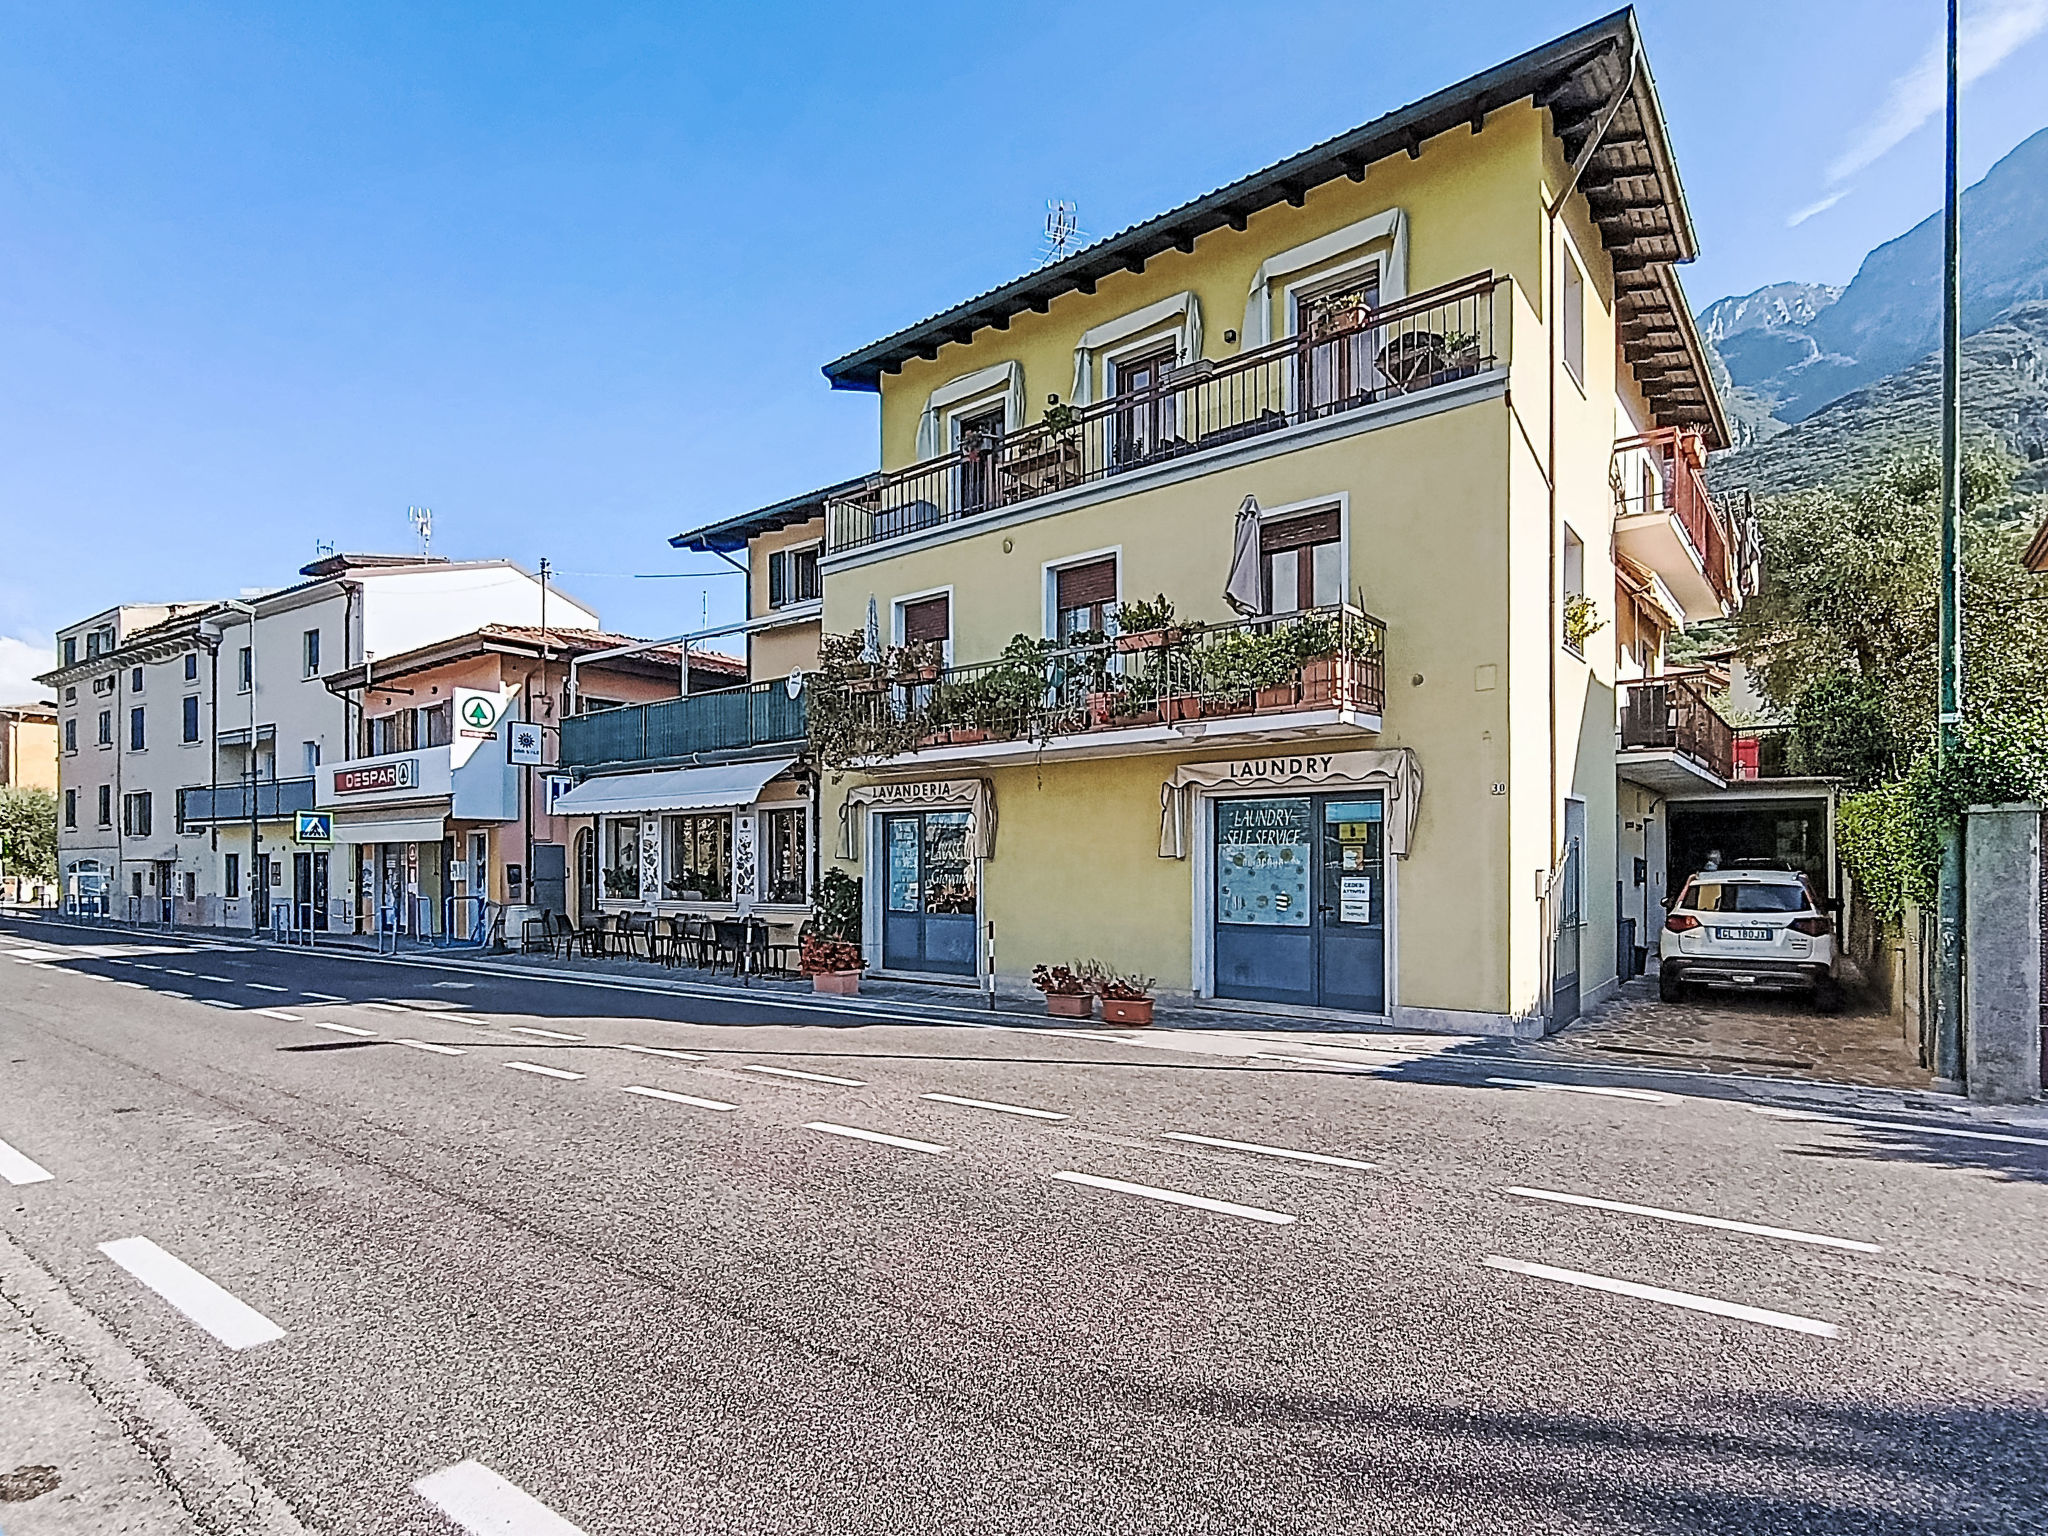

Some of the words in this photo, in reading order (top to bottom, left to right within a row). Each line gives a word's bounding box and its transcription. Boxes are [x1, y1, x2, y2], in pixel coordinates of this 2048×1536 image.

[1230, 756, 1332, 778] LAUNDRY
[345, 768, 396, 788] DESPAR
[872, 782, 950, 798] LAVANDERIA
[1492, 783, 1505, 793] 30
[1234, 808, 1293, 827] LAUNDRY
[1227, 829, 1253, 845] SELF
[1255, 829, 1301, 846] SERVICE
